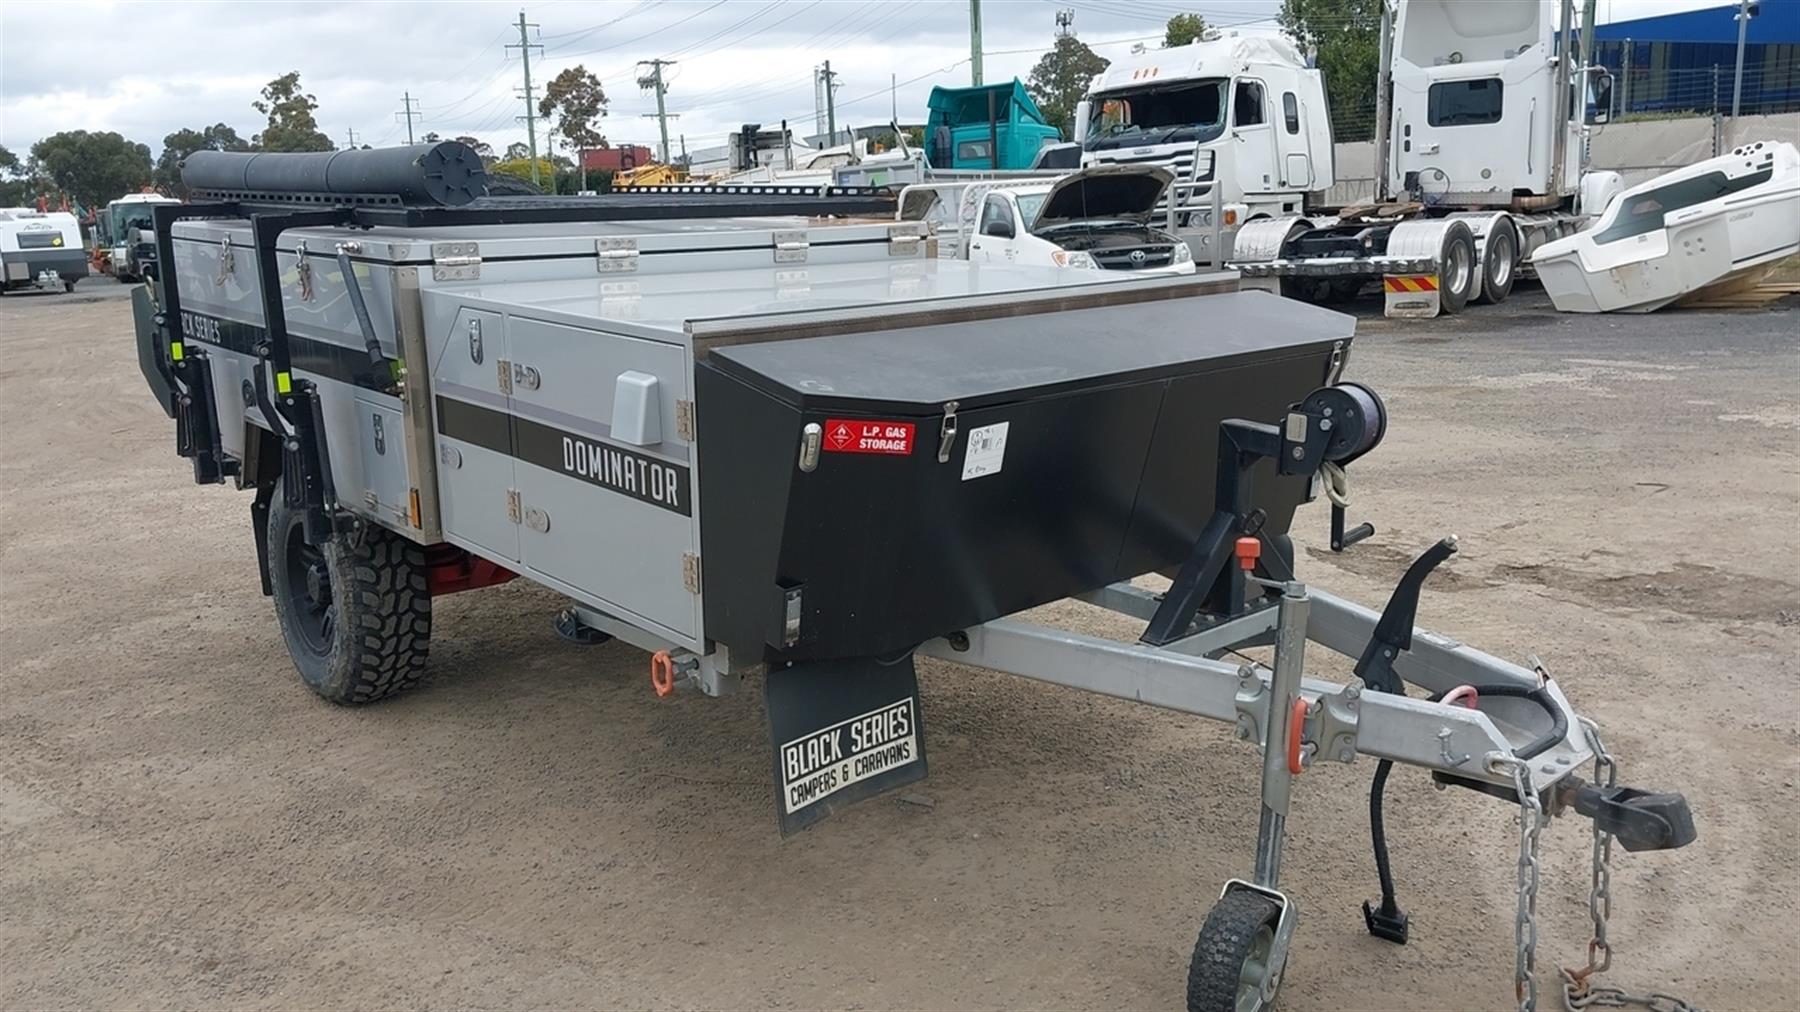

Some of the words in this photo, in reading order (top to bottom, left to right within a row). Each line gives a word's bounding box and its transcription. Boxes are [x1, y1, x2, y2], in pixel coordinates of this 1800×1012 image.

[195, 315, 220, 343] SERIES
[859, 438, 906, 450] STORAGE
[863, 426, 882, 437] L.P.
[885, 427, 906, 438] GAS
[563, 436, 678, 506] DOMINATOR
[786, 729, 842, 781] BLACK
[851, 705, 908, 753] SERIES
[790, 769, 837, 807] CAMPERS
[842, 764, 849, 782] &
[854, 741, 910, 777] CARAVANS
